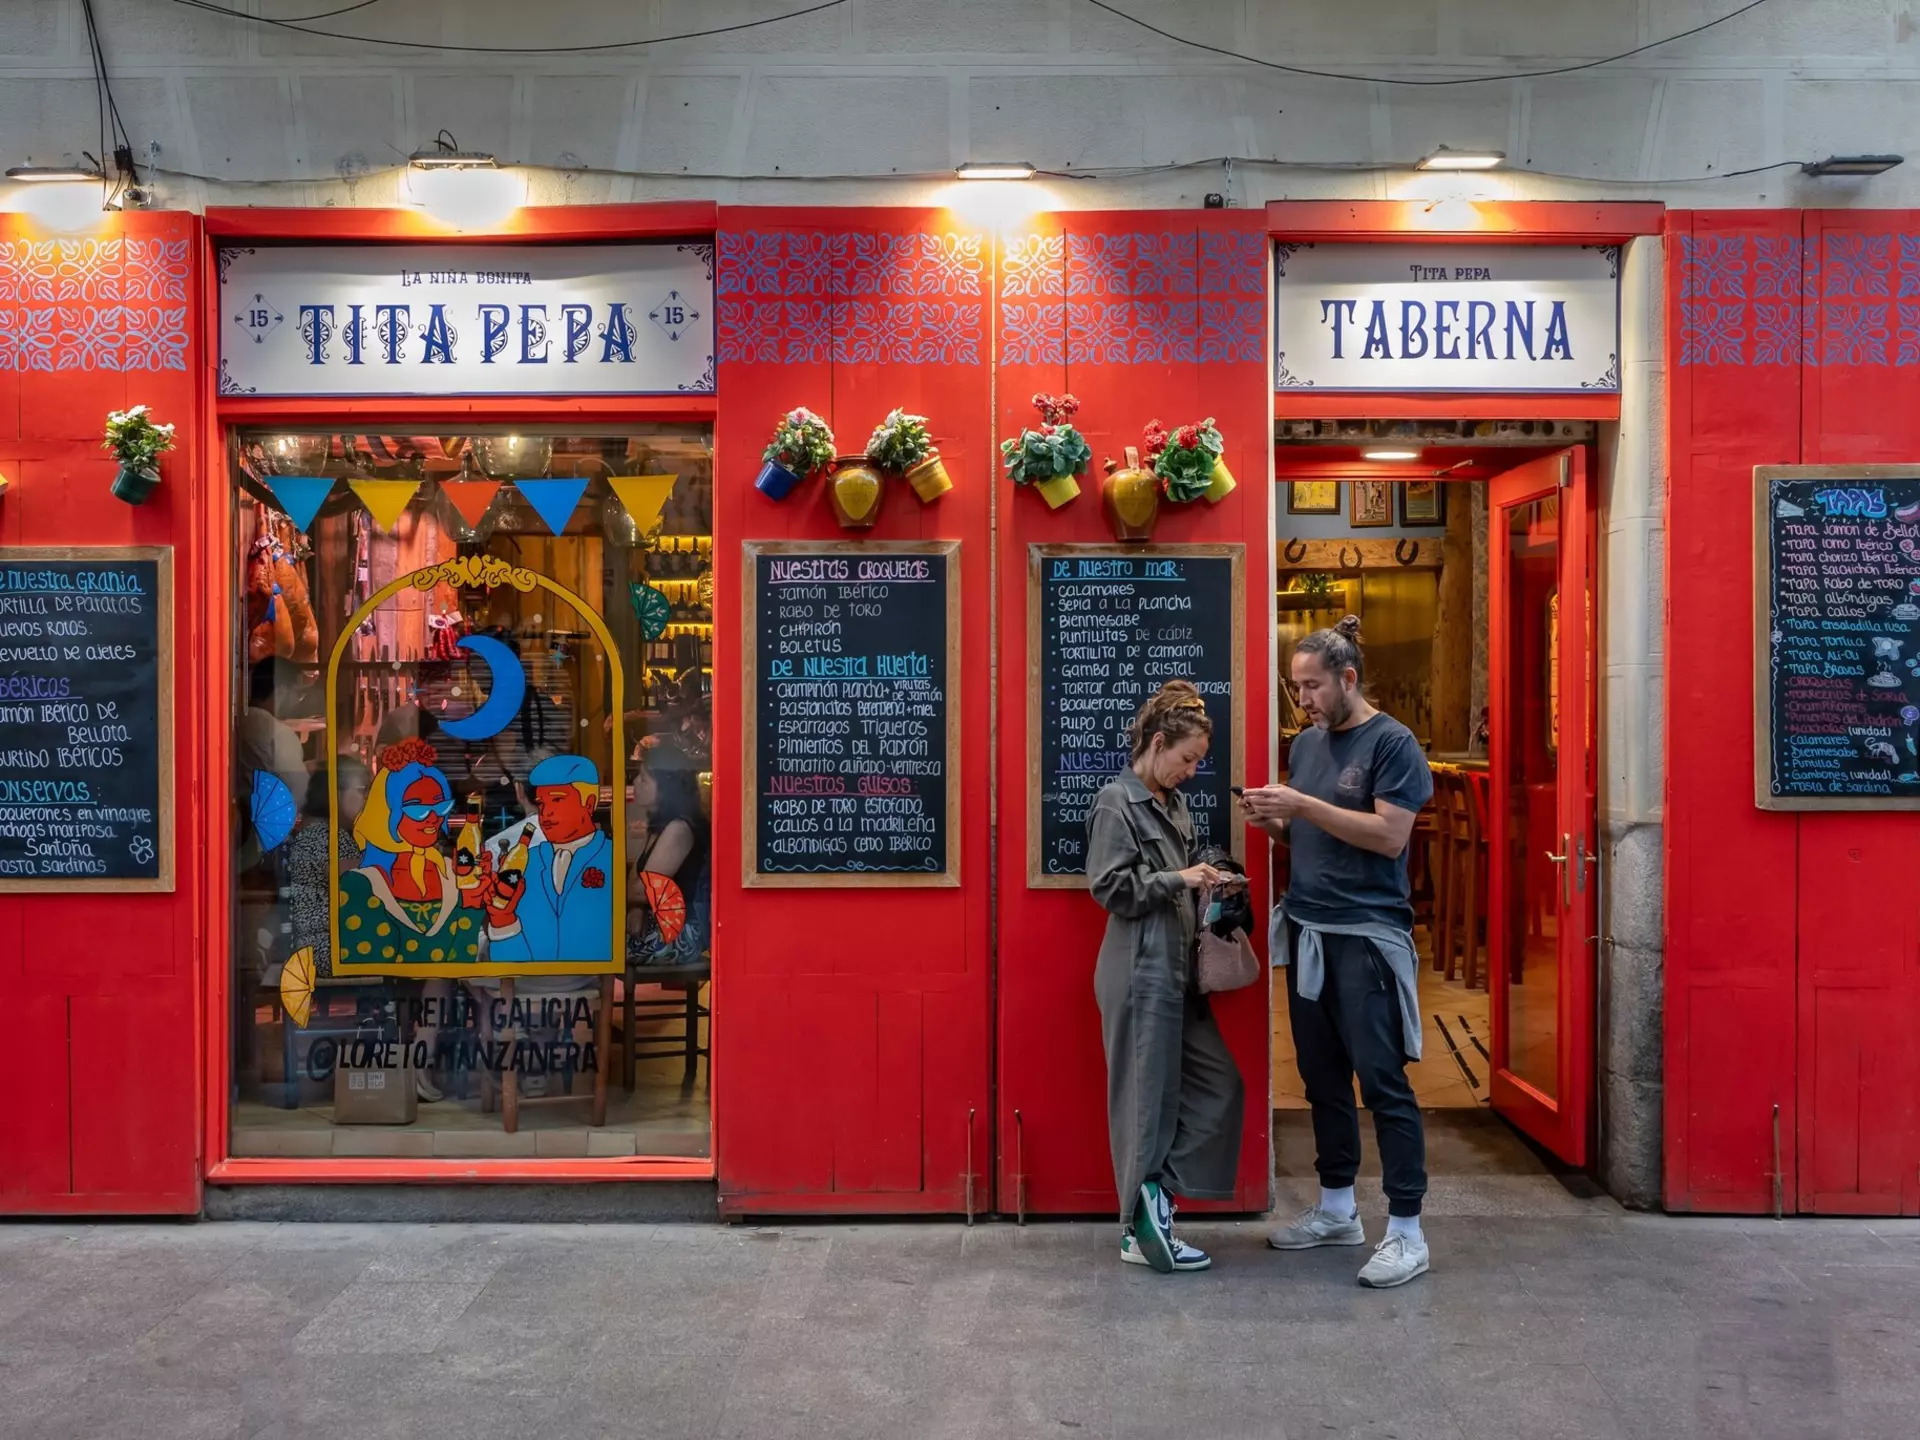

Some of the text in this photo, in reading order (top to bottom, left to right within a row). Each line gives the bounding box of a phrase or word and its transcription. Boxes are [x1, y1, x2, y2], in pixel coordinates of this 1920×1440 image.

[429, 269, 469, 285] NIÑA
[476, 271, 532, 285] BONITA
[1410, 264, 1492, 282] TITA PEPA
[249, 310, 268, 327] 15
[664, 307, 684, 324] 15
[296, 302, 638, 365] TITA PEPA
[1320, 300, 1575, 361] TABERNA
[1815, 489, 1887, 518] TAPAS
[1865, 520, 1879, 535] de
[1883, 524, 1920, 539] Bellot
[1822, 539, 1850, 549] lomo
[1856, 539, 1893, 551] Ibérico
[1819, 552, 1858, 563] chorizo
[1863, 551, 1898, 562] Ibérico
[1858, 578, 1872, 589] de
[1825, 591, 1893, 612] albóndigas
[0, 622, 42, 636] uevos
[1822, 620, 1881, 632] ensaladilla
[1884, 622, 1911, 632] rusa
[1848, 727, 1891, 736] (unidad)
[1790, 736, 1850, 745] Calamares
[1850, 769, 1891, 780] (unidad)
[1829, 780, 1843, 791] de
[1847, 783, 1891, 793] sardina
[78, 808, 94, 820] en
[96, 805, 151, 829] vinagre
[0, 823, 45, 837] nchoas
[24, 839, 95, 856] Santoña
[41, 858, 106, 874] sardinas
[490, 997, 594, 1029] GALICIA
